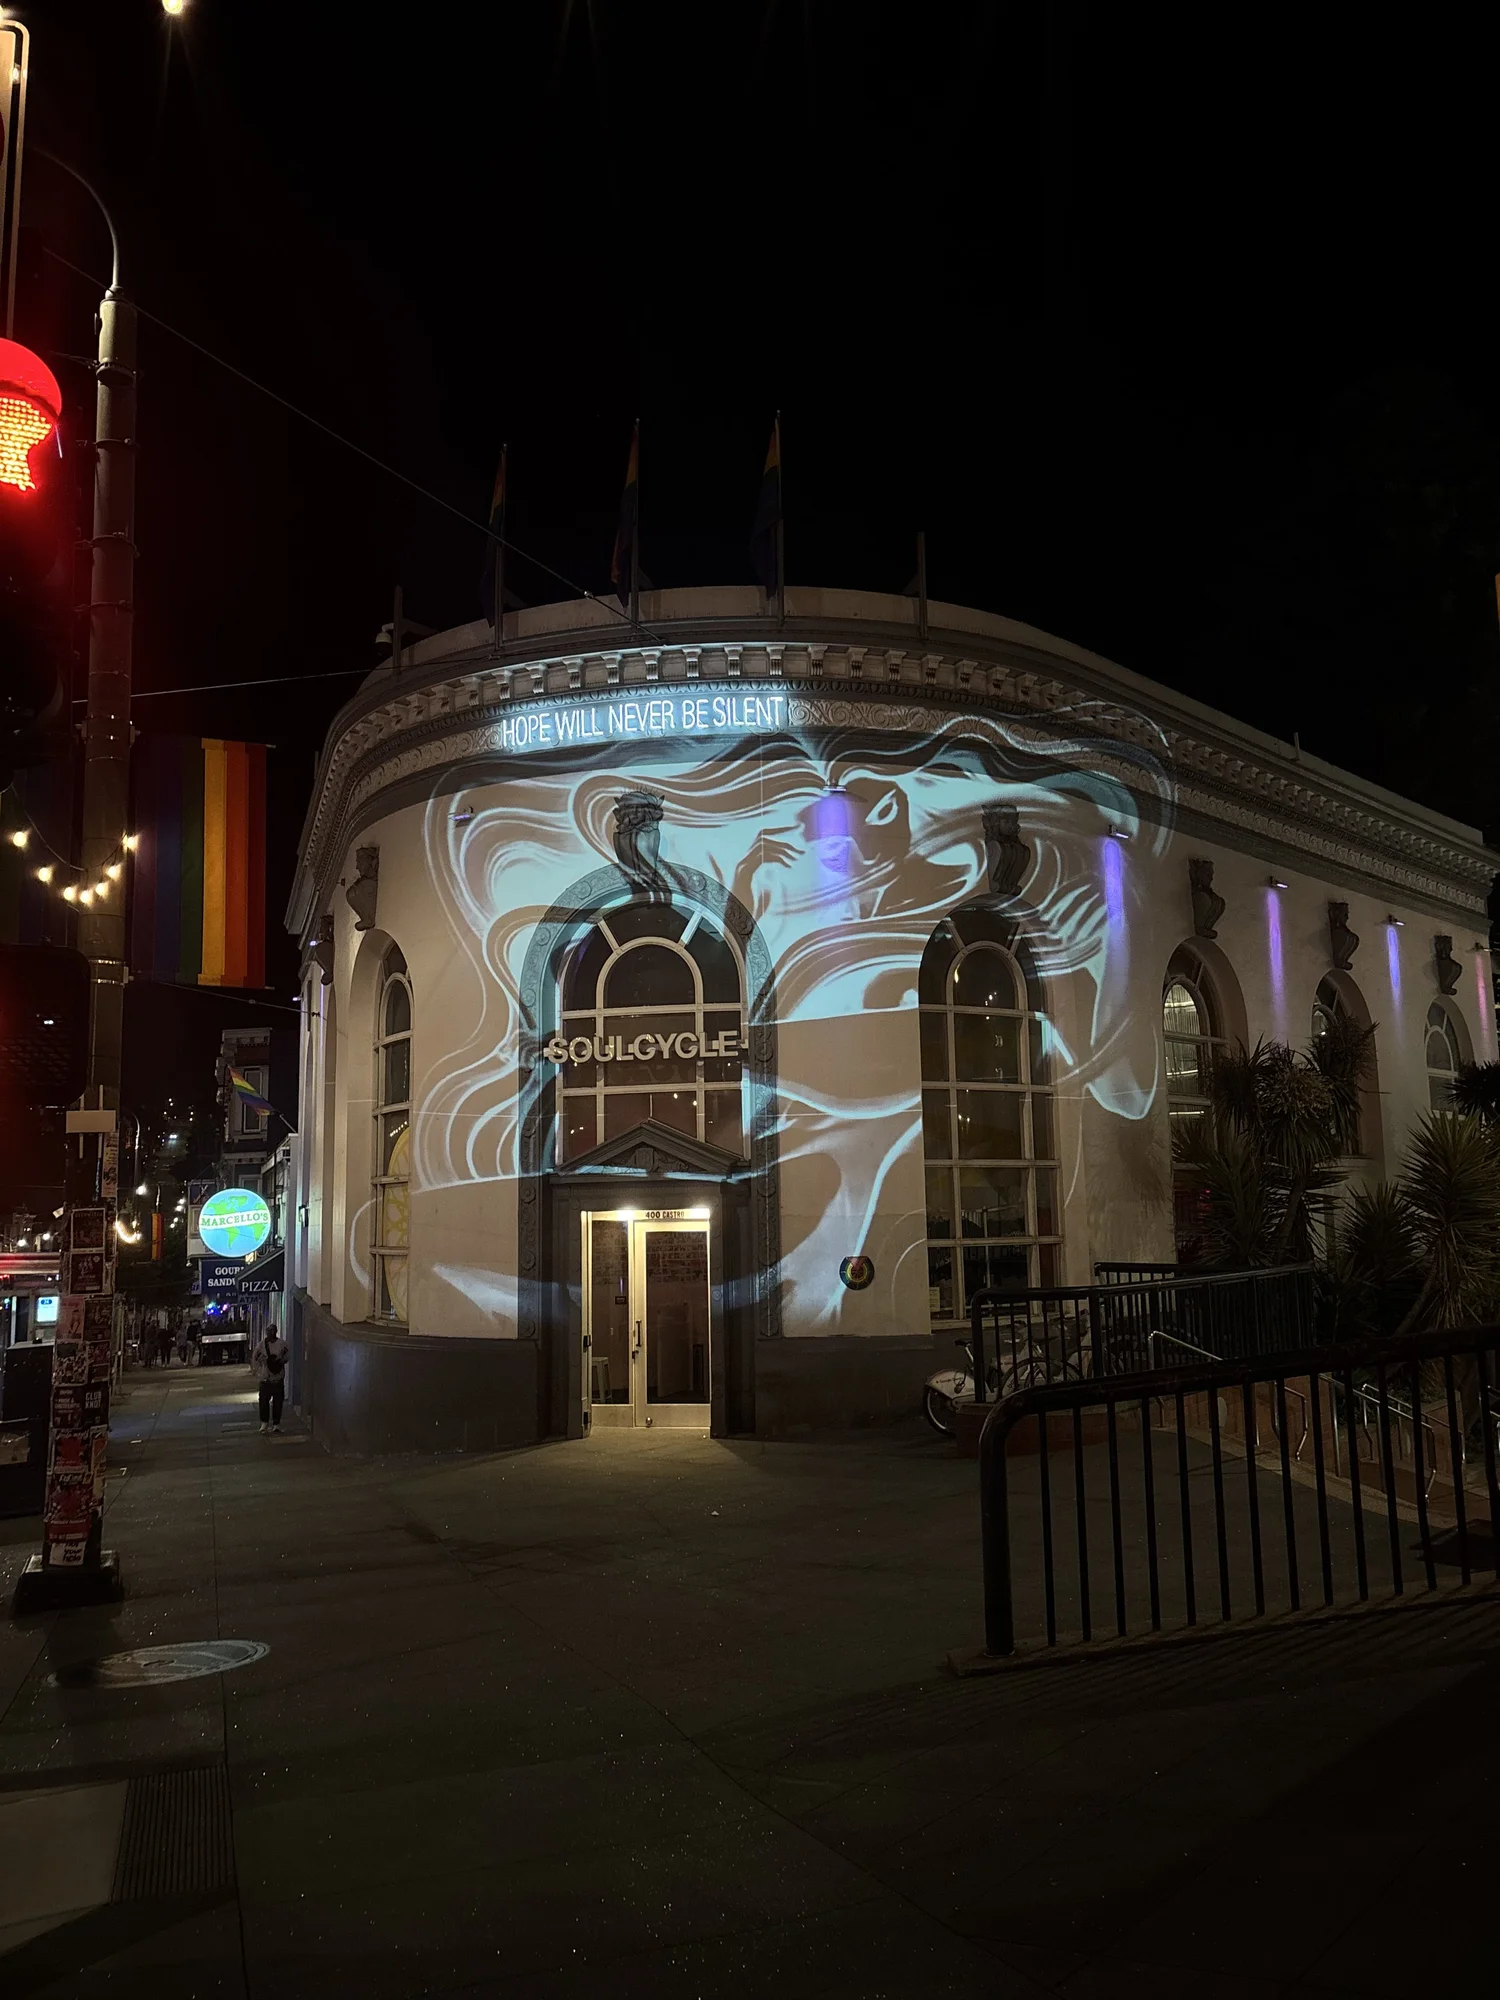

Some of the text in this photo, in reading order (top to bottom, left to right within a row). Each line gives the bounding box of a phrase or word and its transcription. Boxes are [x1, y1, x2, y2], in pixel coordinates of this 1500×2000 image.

[502, 696, 784, 747] HOPE WILL NEVER BE SILENT
[547, 1030, 739, 1064] SOULCYCLE
[201, 1213, 269, 1227] MARCELLO'S
[645, 1210, 685, 1219] 400 CASTRO
[241, 1280, 279, 1292] PIZZA
